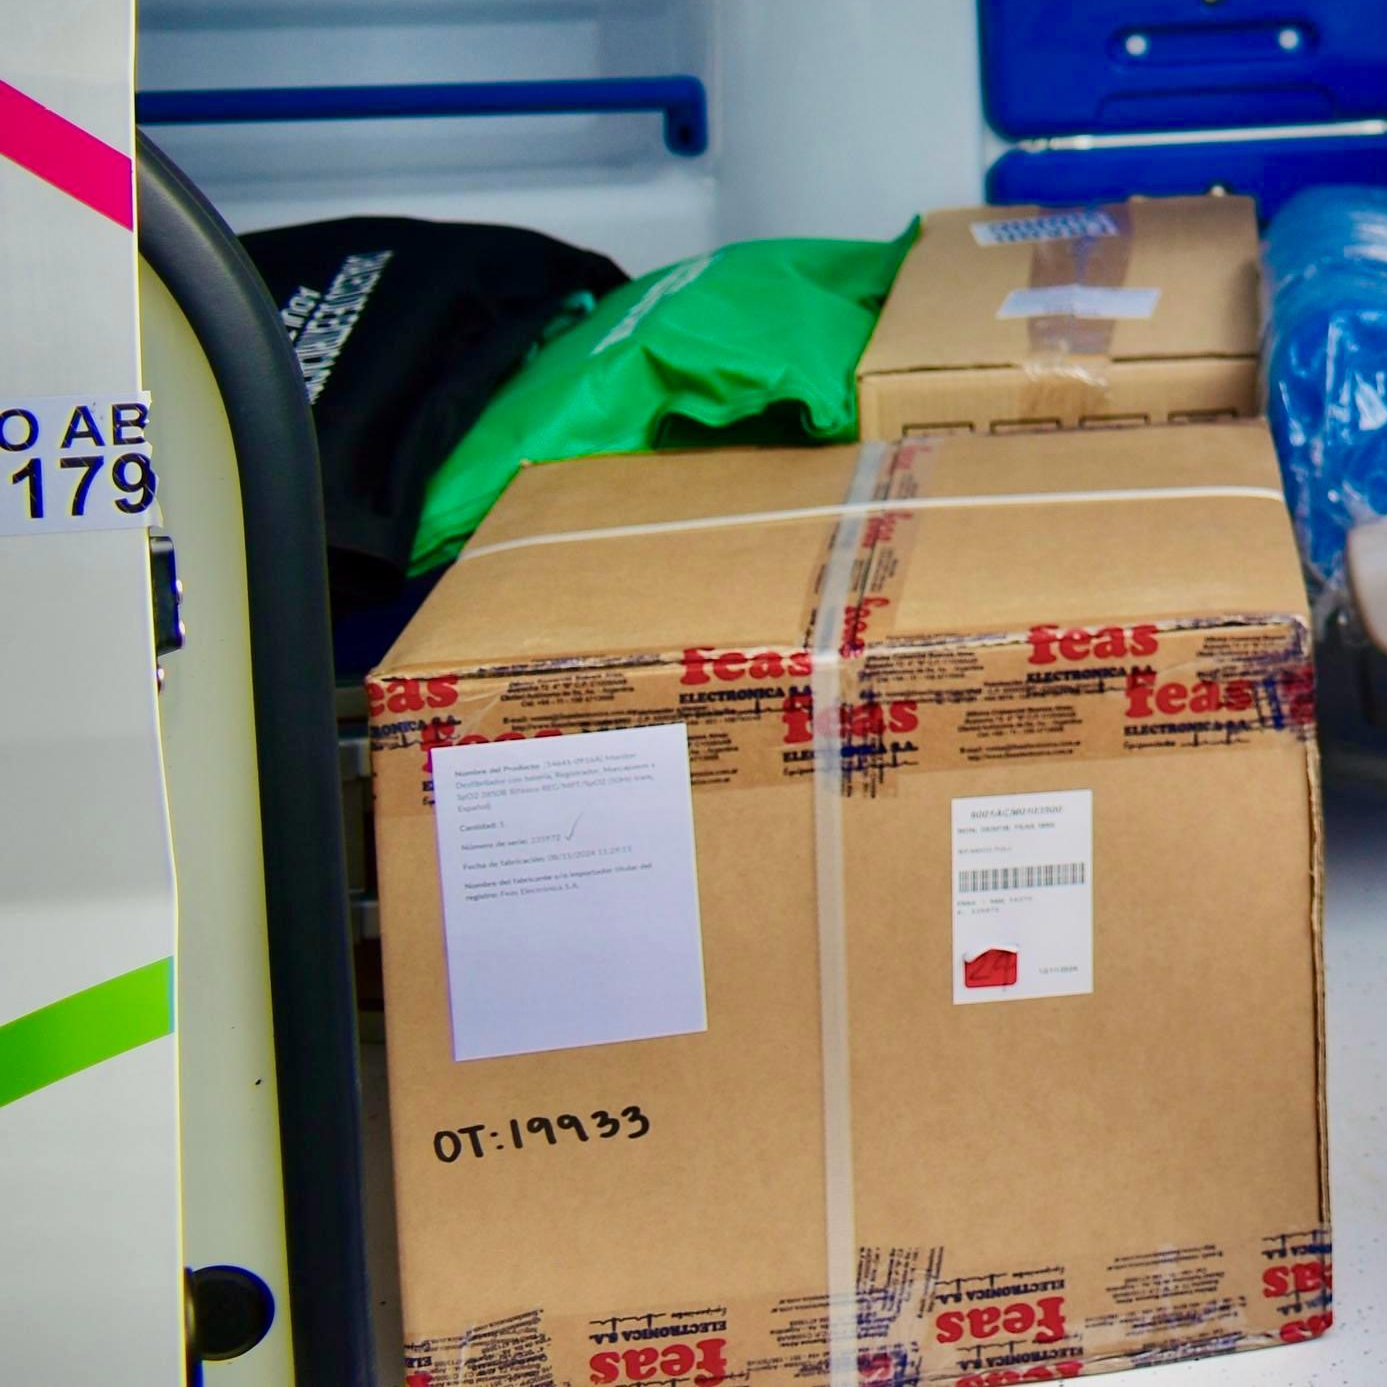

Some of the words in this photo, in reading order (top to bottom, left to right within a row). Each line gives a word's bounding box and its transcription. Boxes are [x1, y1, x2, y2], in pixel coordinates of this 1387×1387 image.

[60, 403, 149, 449] AB
[12, 452, 157, 519] 179
[1027, 622, 1158, 664] feas
[680, 647, 813, 685] feas
[680, 688, 785, 704] ELECTRONICA
[1124, 672, 1254, 718] feas
[783, 700, 918, 744] fas
[433, 1105, 651, 1163] OT:19933
[968, 1279, 1066, 1301] ELECTRONICA
[621, 1320, 727, 1342] ELECTRONICA
[935, 1296, 1066, 1345] feas
[589, 1337, 727, 1386] feas
[986, 1345, 1084, 1367] ELECTRONICA
